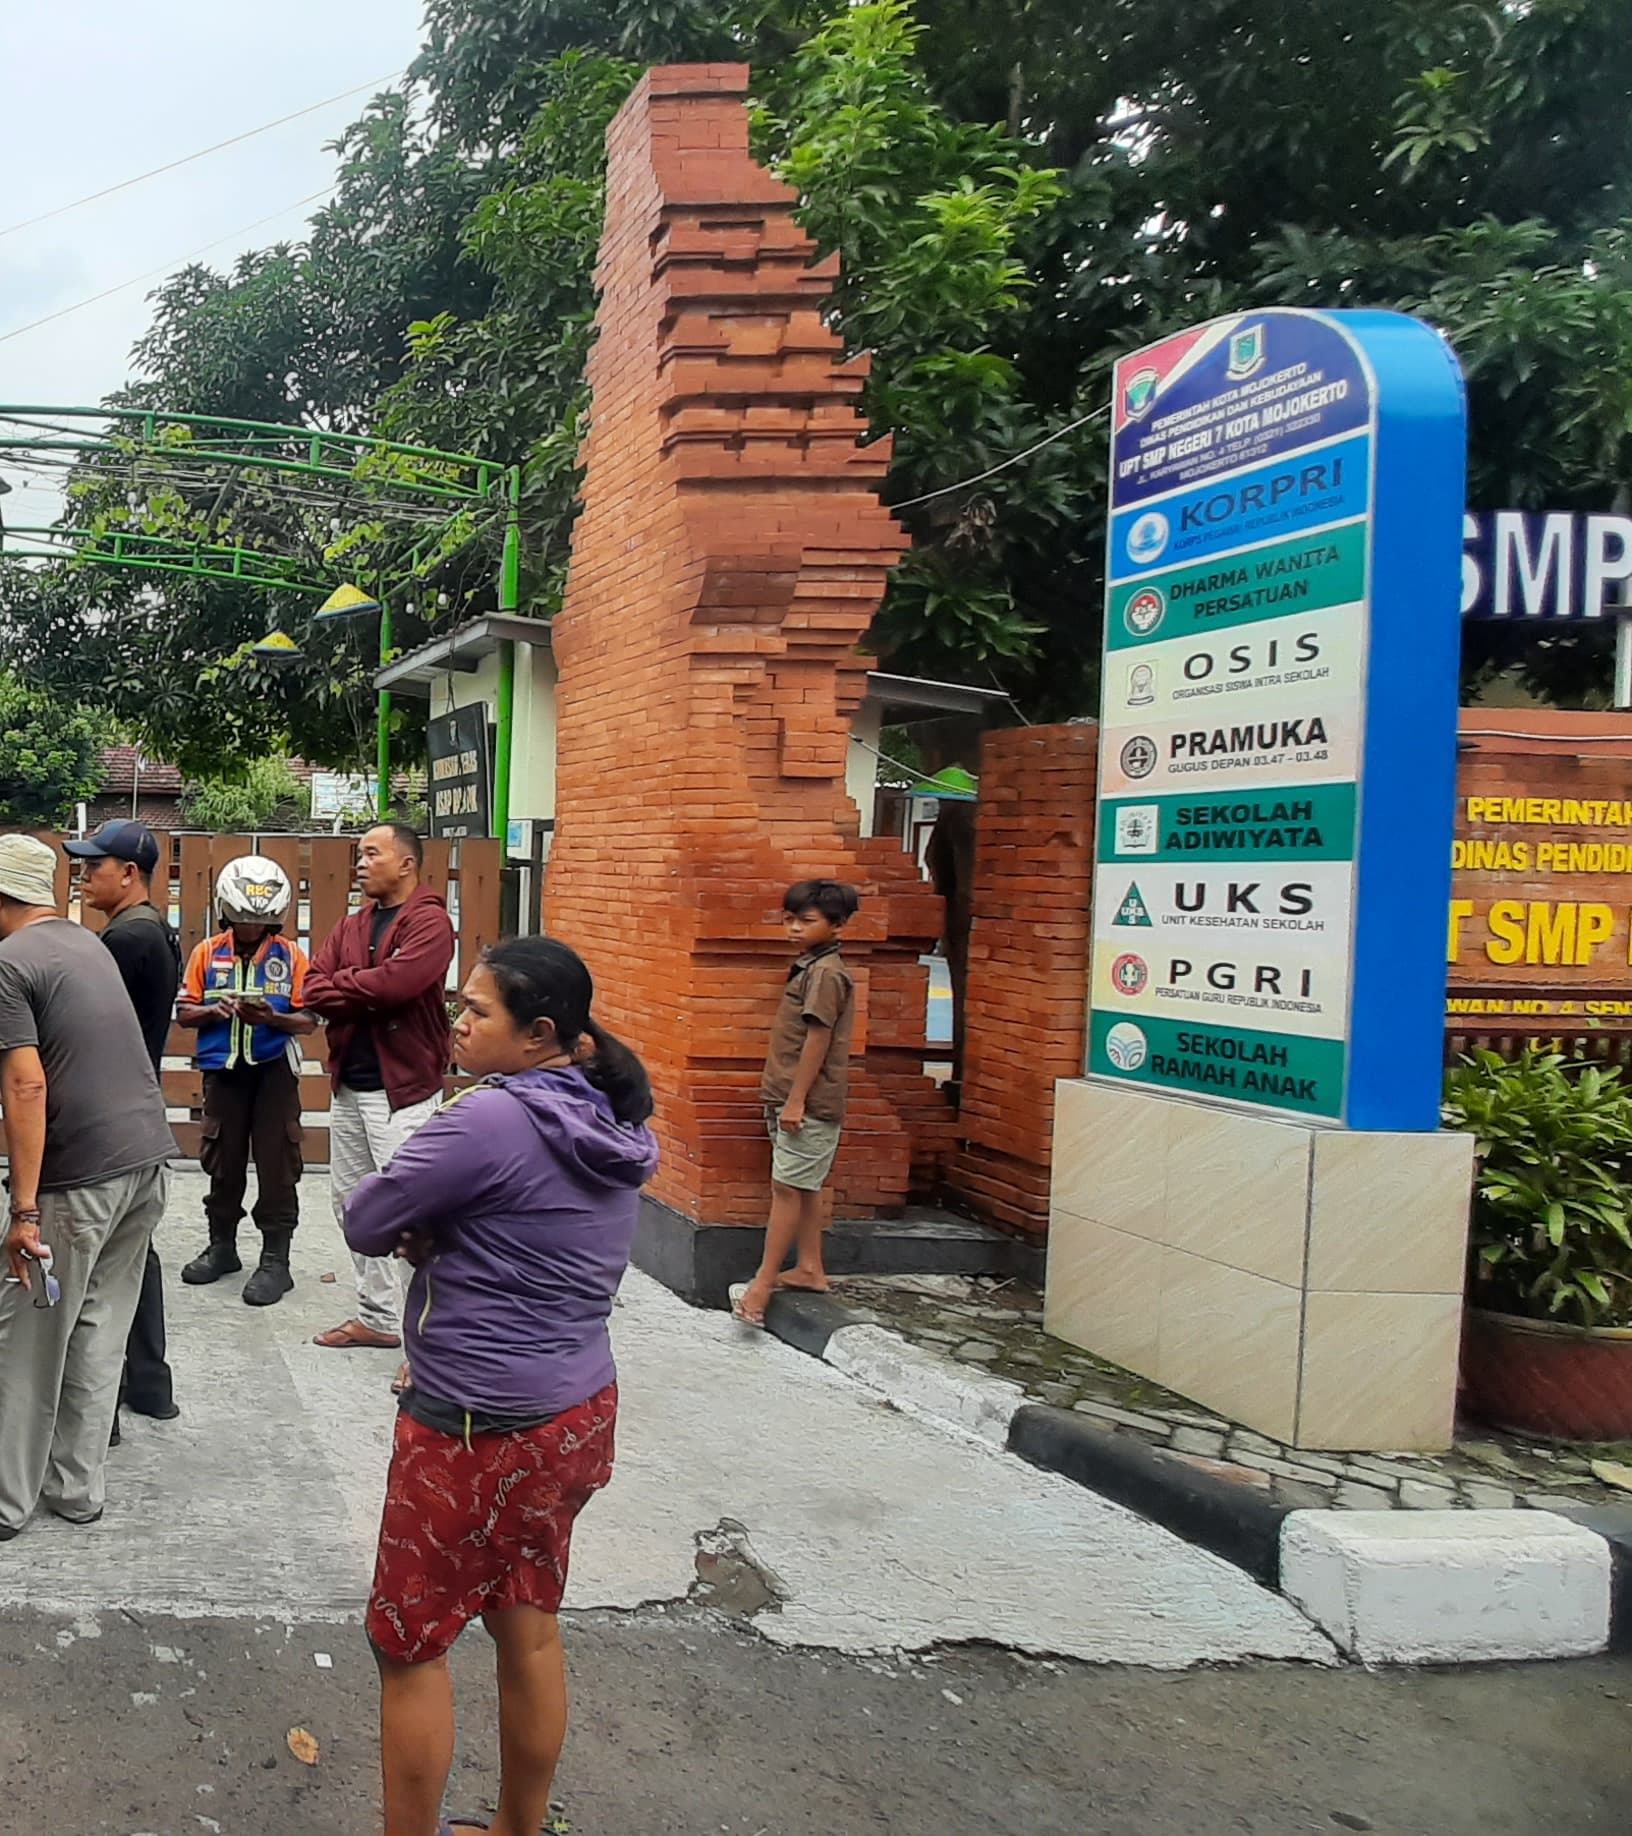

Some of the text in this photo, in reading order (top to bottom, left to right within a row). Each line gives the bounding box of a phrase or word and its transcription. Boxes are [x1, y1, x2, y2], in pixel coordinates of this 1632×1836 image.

[1212, 390, 1239, 407] KOTA
[1240, 362, 1307, 395] MOJOKERTO
[1227, 401, 1249, 417] DAN
[1119, 380, 1348, 478] UPT SMP NEGERI 7 KOTA MOJOKERTO
[1179, 454, 1238, 481] MOJOKERTO
[1180, 458, 1343, 532] KORPRI
[1170, 546, 1340, 601] DHARMA WANITA
[1193, 579, 1309, 619] PERSATUAN
[1172, 667, 1330, 700] ORGANISASI SISWA INTRA SEKOLAH
[1170, 717, 1328, 759] PRAMUKA
[1168, 760, 1209, 773] GUGUS
[1211, 755, 1251, 770] DEPAN
[1254, 753, 1285, 766] 03.47
[1295, 750, 1329, 763] 03.48
[1176, 801, 1313, 825] SEKOLAH
[1165, 826, 1324, 850] ADIWIYATA
[1451, 840, 1528, 872] DINAS
[246, 884, 273, 898] RBC
[1161, 915, 1325, 931] UNIT KESEHATAN SEKOLAH
[1487, 900, 1614, 966] SMP
[1155, 987, 1322, 1013] PERSATUAN GURU REPUBLIK INDONESIA
[1177, 1032, 1288, 1067] SEKOLAH
[1151, 1055, 1317, 1101] RAMAH ANAK
